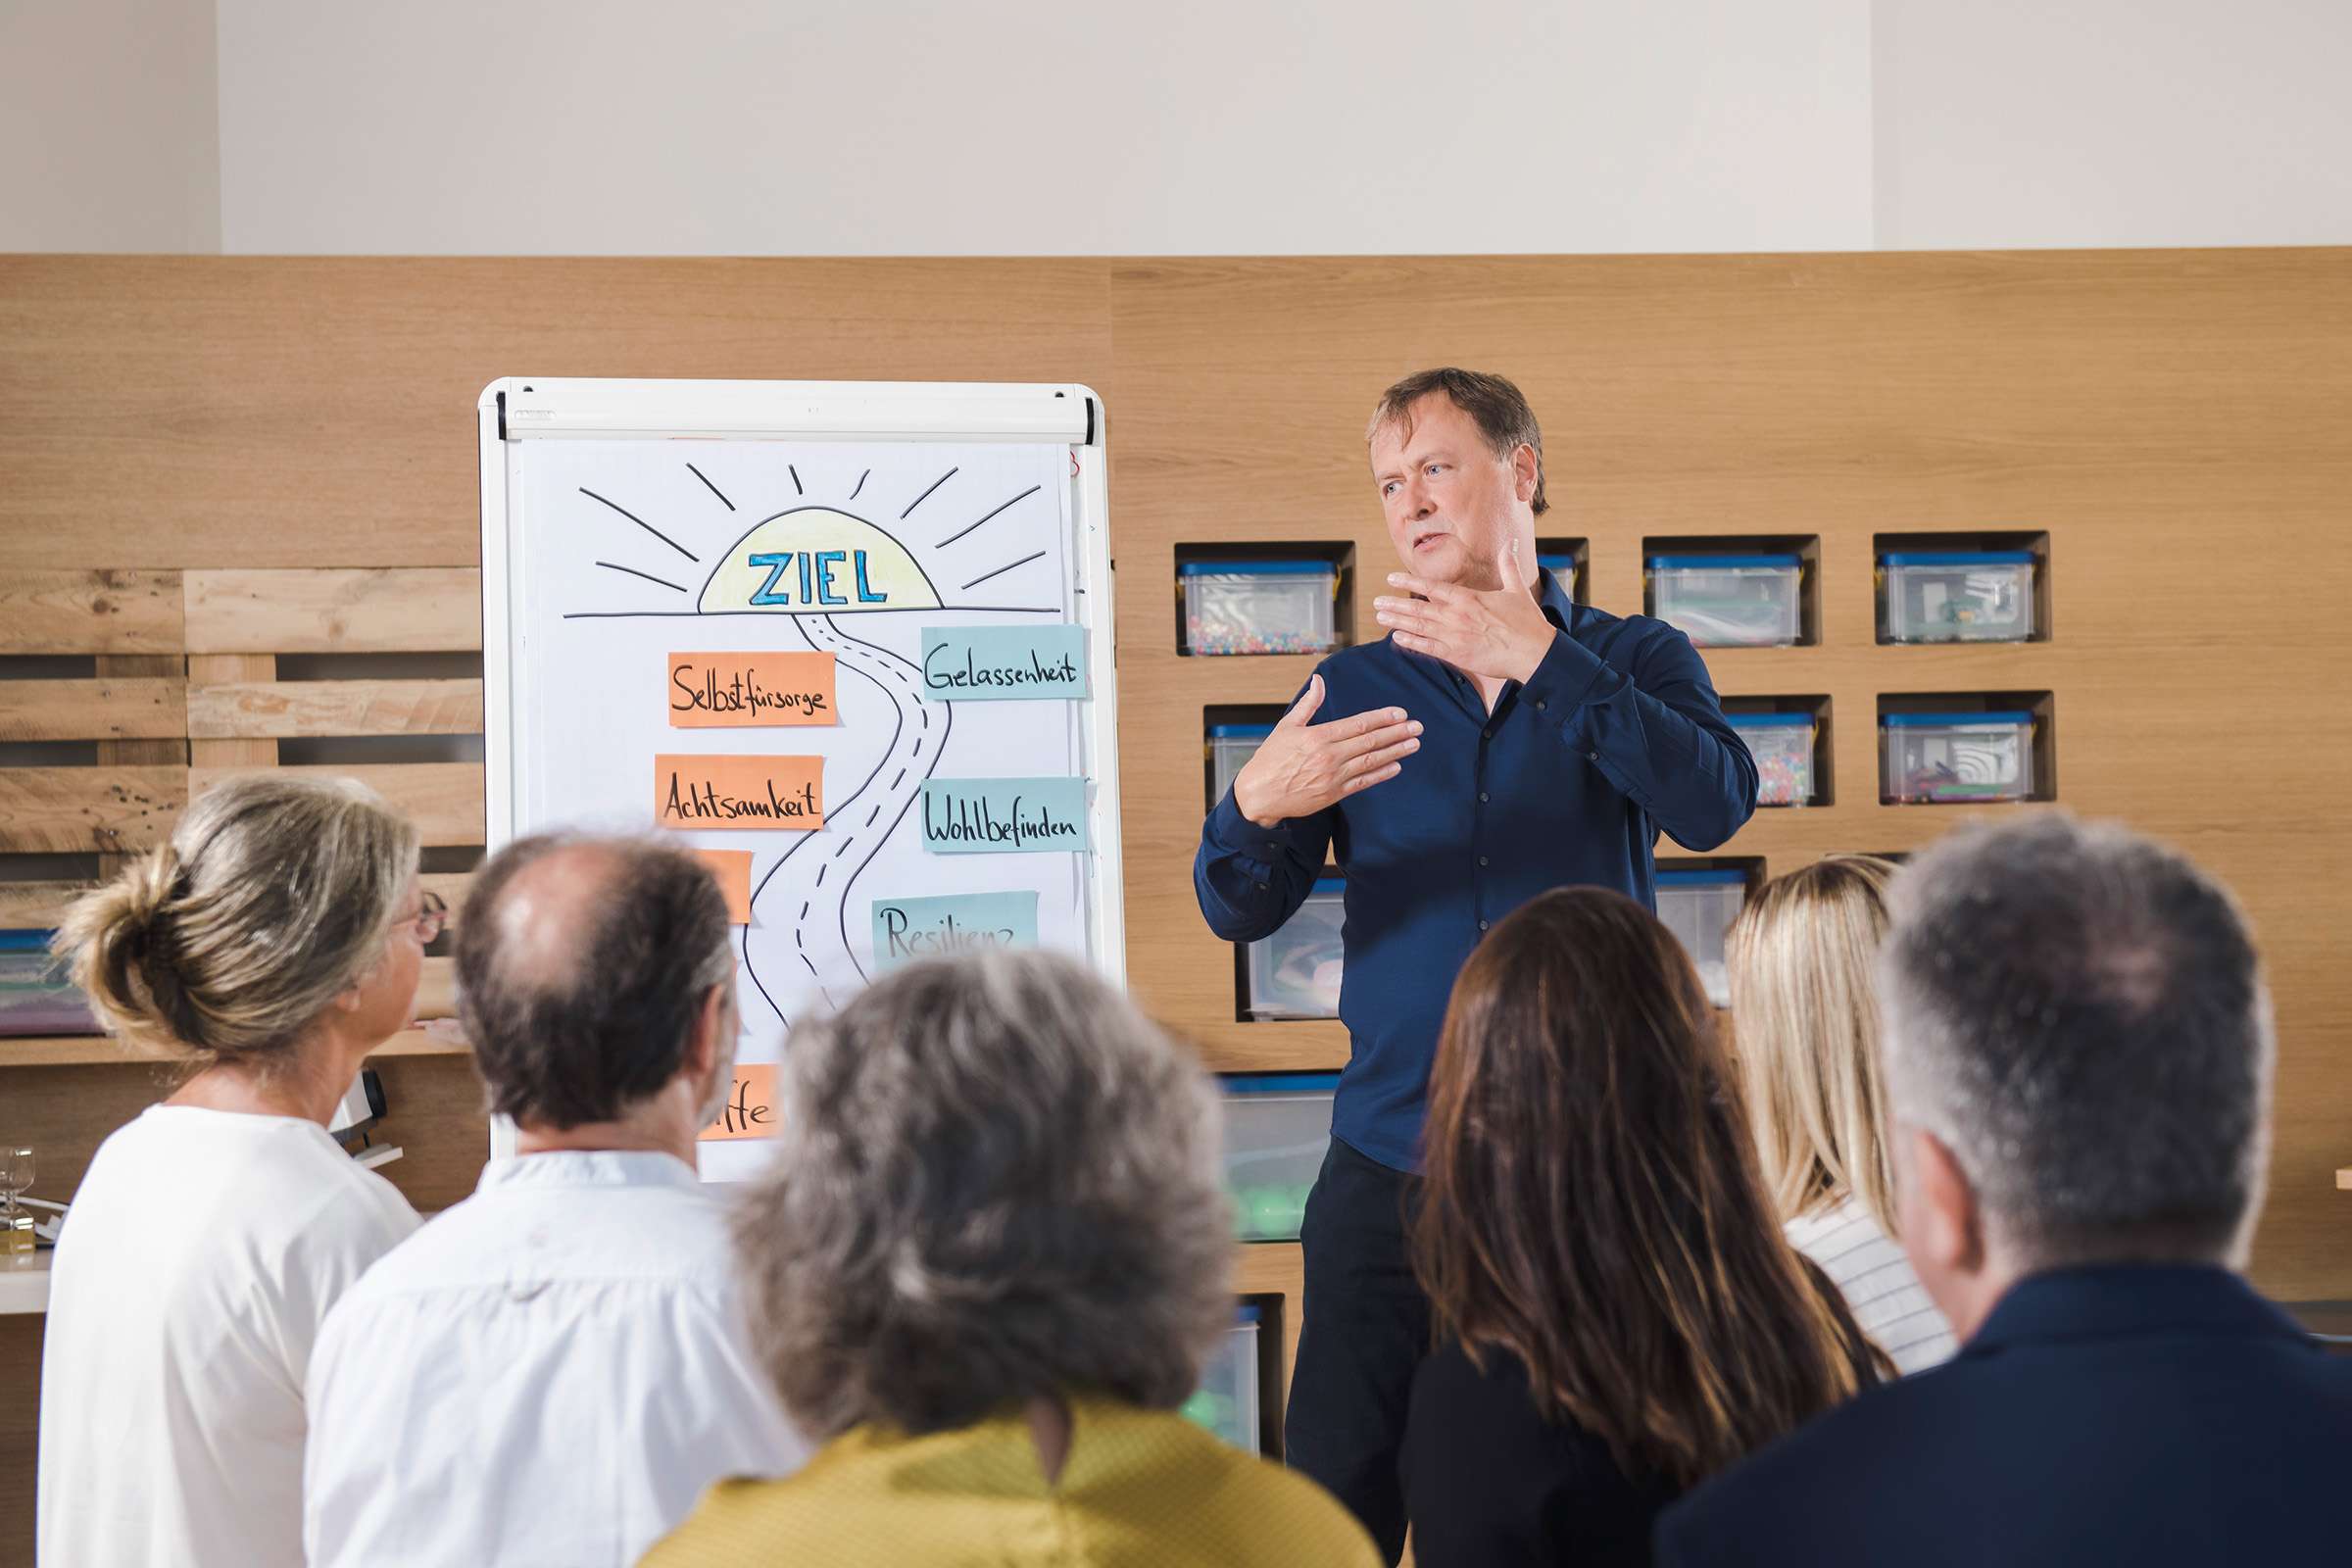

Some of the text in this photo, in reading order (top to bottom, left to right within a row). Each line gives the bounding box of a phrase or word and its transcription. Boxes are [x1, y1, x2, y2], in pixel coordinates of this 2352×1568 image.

[748, 549, 888, 607] ZIEL
[671, 664, 827, 717] Selbstfürsorge
[924, 642, 1077, 689] Gelassenheit
[663, 771, 821, 819] Achtsamkeit
[924, 790, 1077, 847] Wohlbefinden
